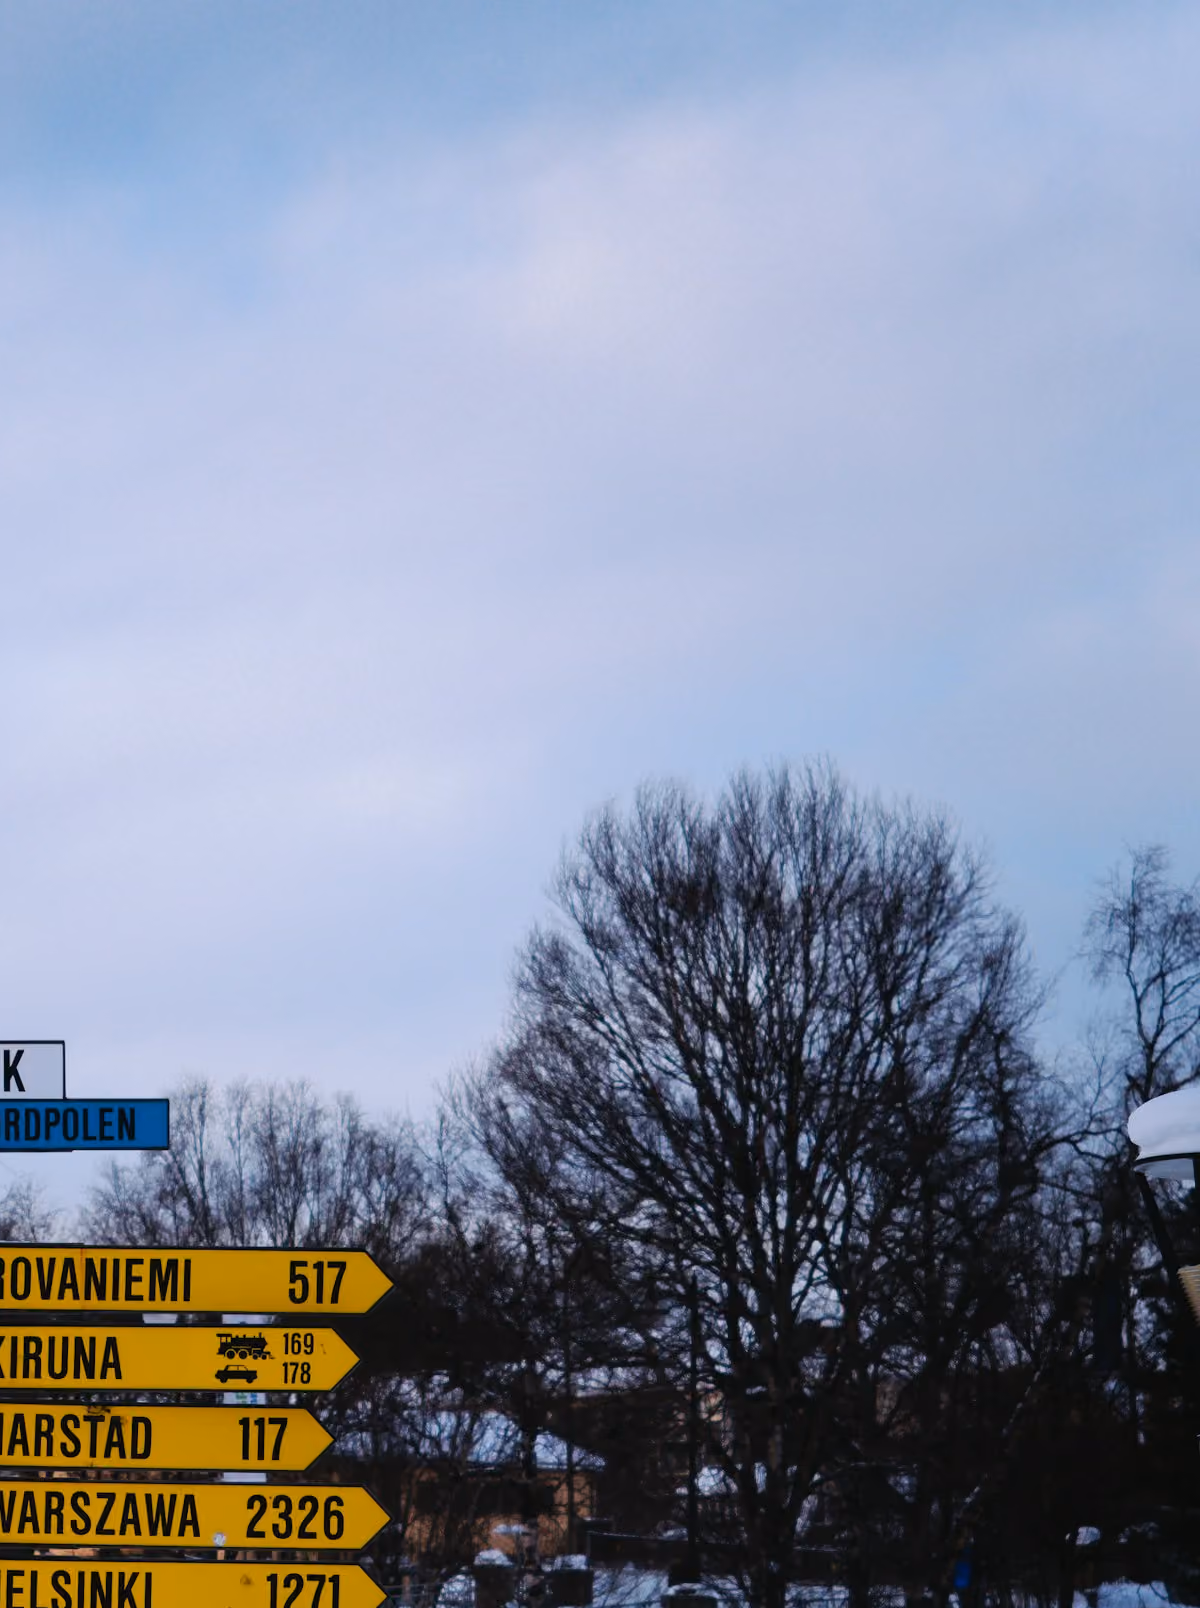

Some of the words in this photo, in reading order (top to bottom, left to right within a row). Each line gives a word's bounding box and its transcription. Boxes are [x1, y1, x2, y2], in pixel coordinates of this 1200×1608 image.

[289, 1261, 346, 1304] 517
[283, 1333, 314, 1355] 169
[283, 1362, 310, 1384] 178
[239, 1417, 287, 1460] 117
[247, 1495, 344, 1540] 2326
